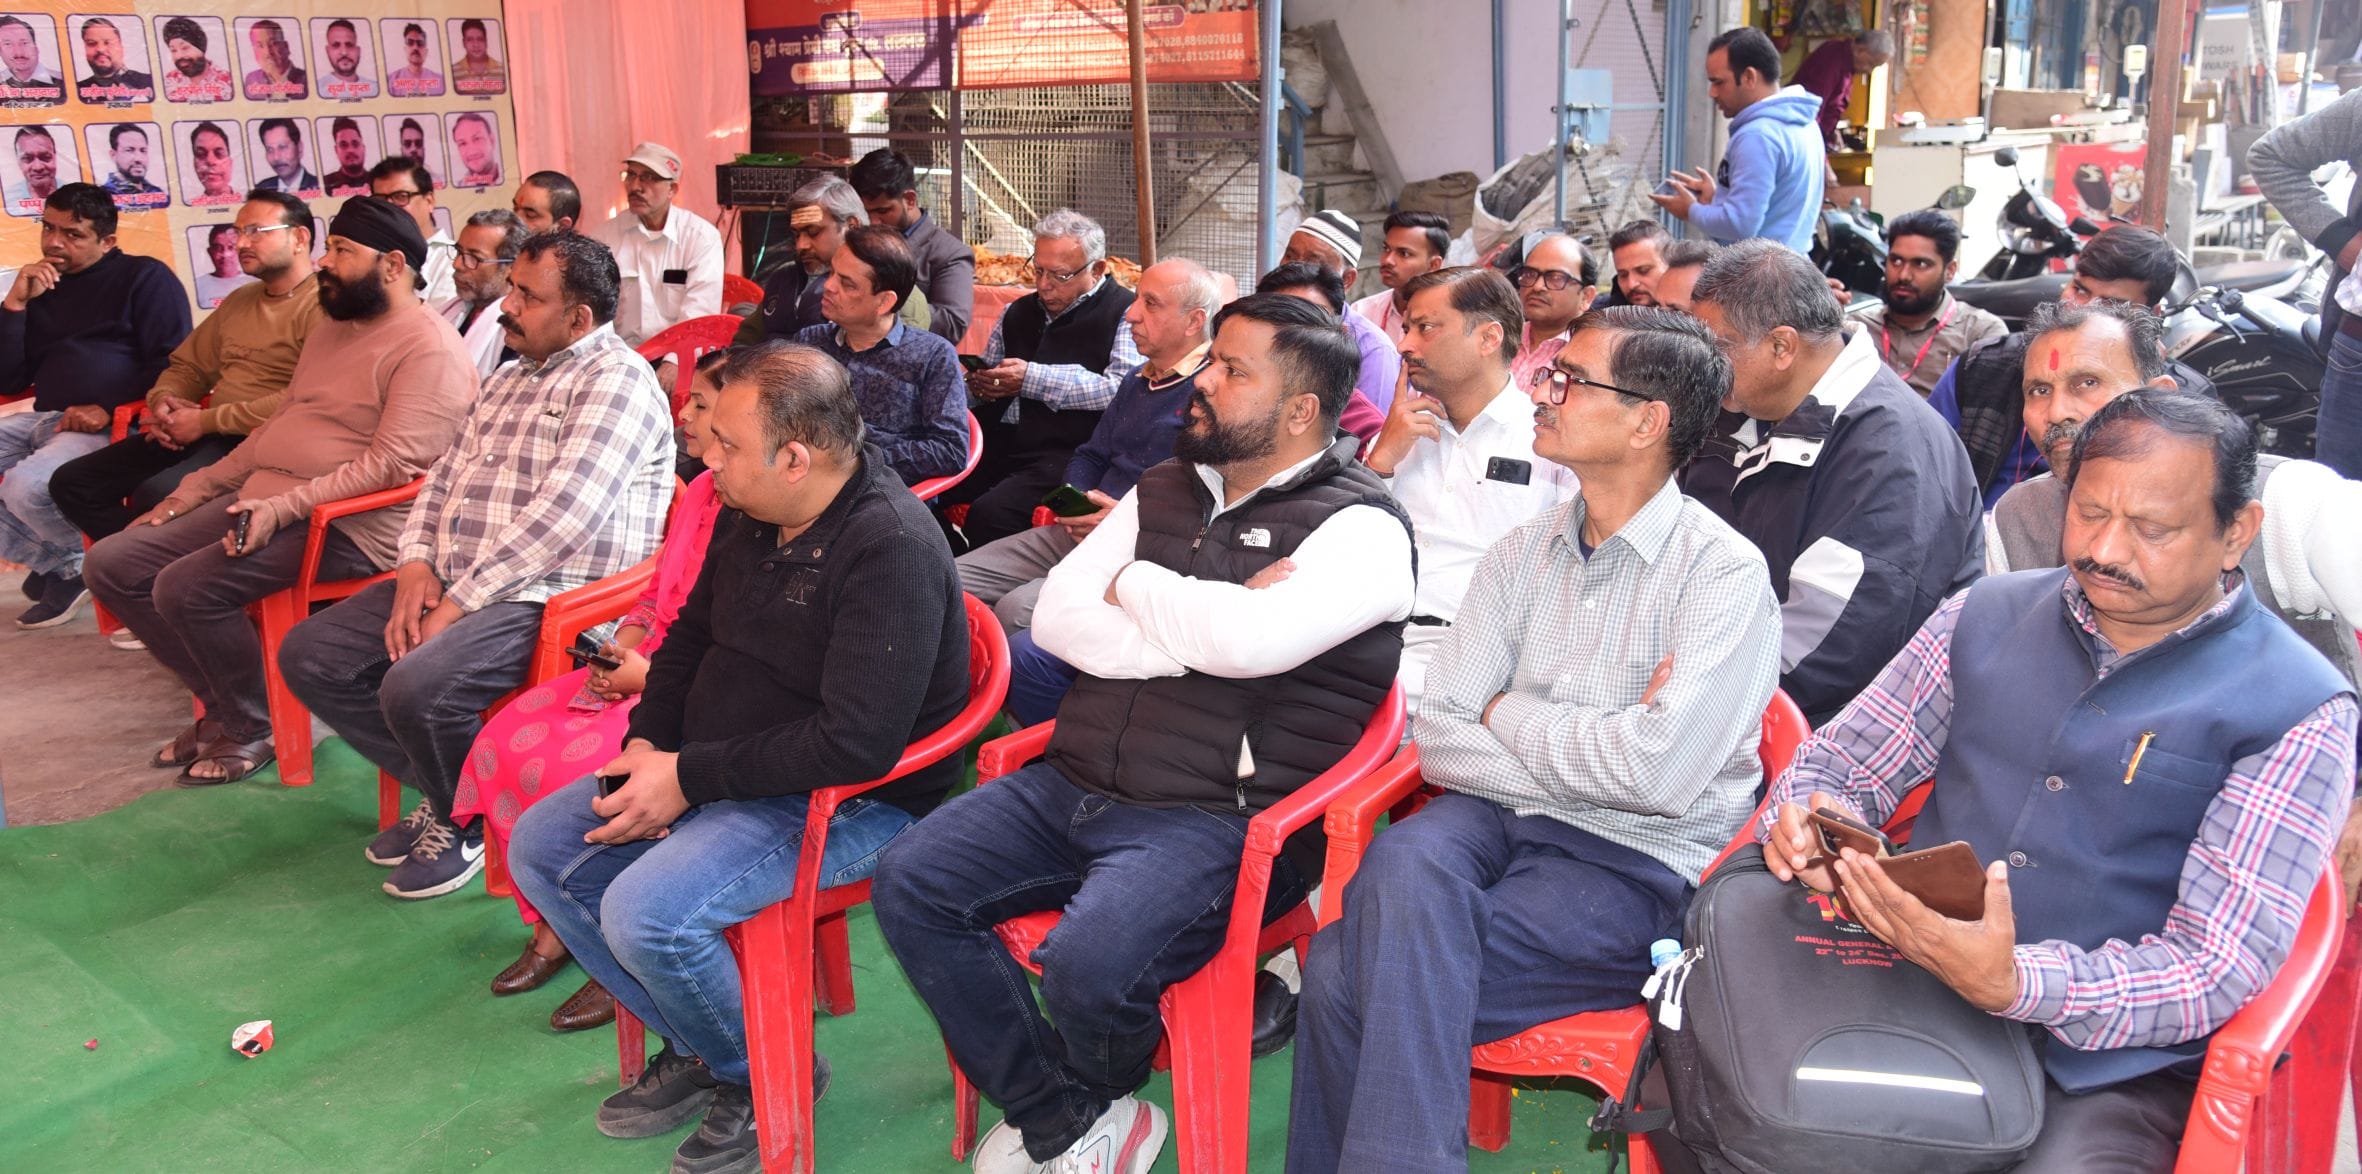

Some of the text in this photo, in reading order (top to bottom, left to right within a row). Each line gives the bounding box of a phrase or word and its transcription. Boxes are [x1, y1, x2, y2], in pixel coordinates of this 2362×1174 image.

[764, 37, 776, 59] श्री
[779, 41, 802, 57] श्याम
[1795, 935, 1836, 947] ANNUAL
[1837, 940, 1885, 950] GENERAL
[1835, 949, 1846, 957] to
[1841, 958, 1894, 969] LUCKNOW
